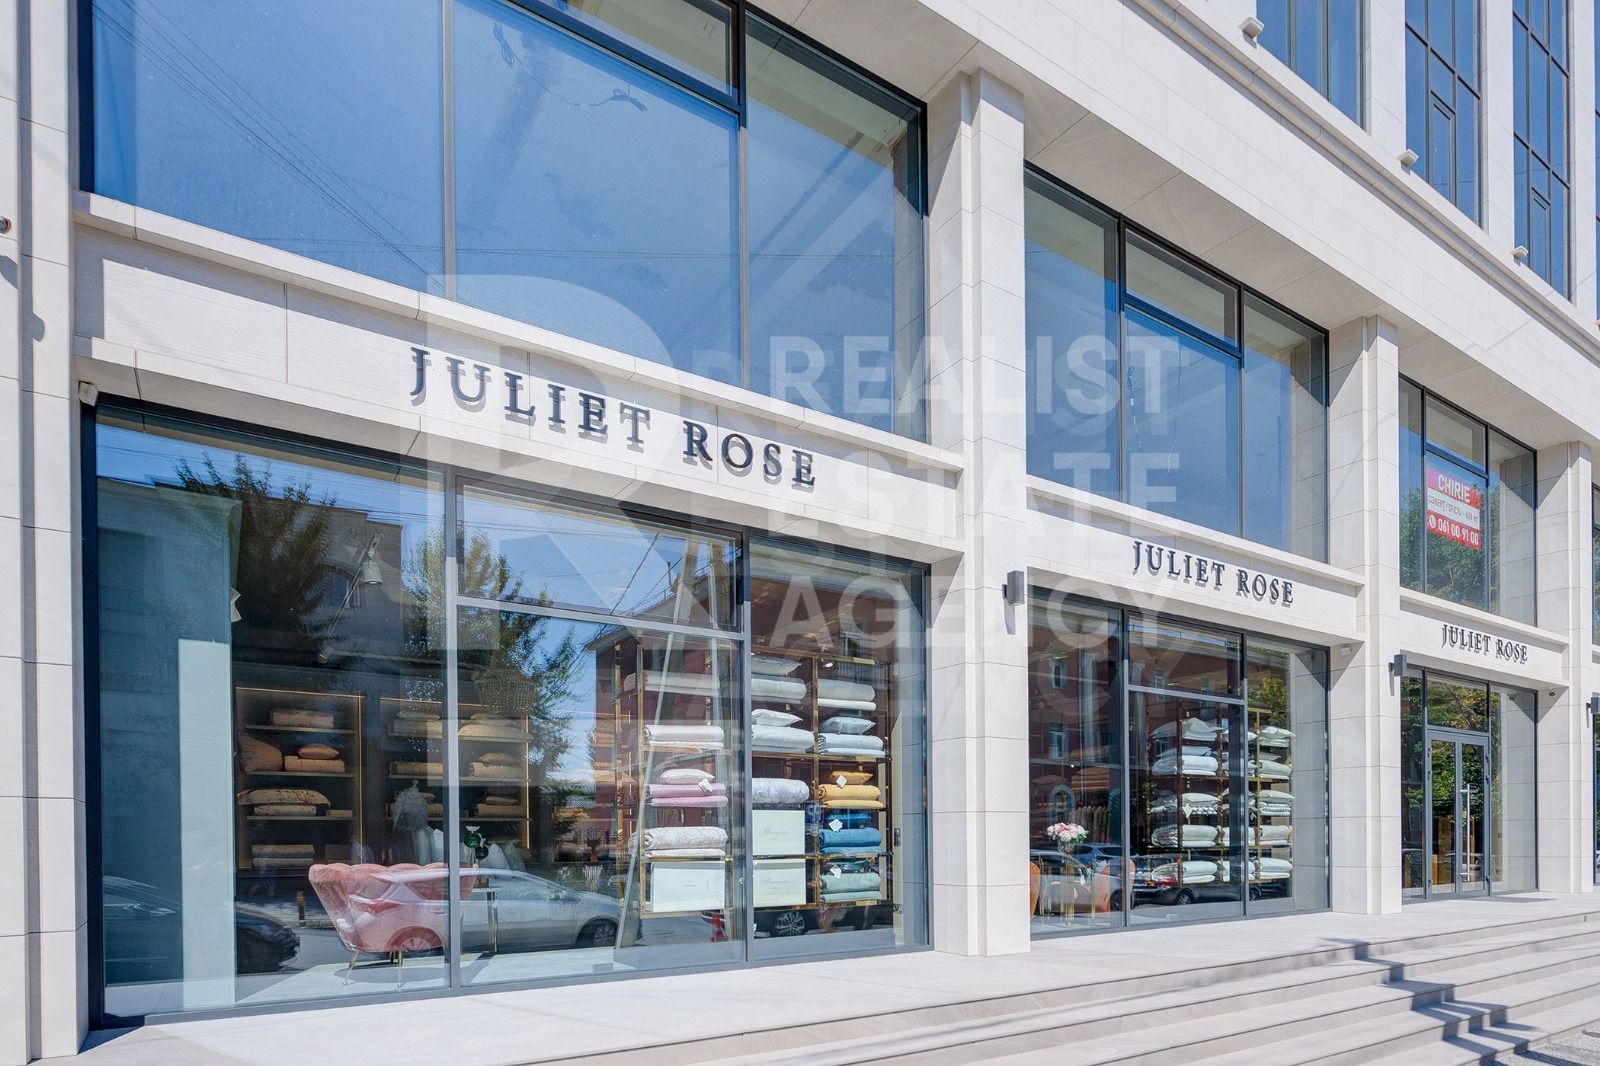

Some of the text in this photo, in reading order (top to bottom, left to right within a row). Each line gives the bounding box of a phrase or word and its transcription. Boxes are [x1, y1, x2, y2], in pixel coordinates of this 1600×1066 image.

[409, 346, 816, 487] JULIET ROSE
[1438, 474, 1471, 504] CHIRIE
[1437, 518, 1450, 534] 061
[1133, 541, 1294, 604] JULIET ROSE
[1442, 624, 1527, 662] JULIET ROSE
